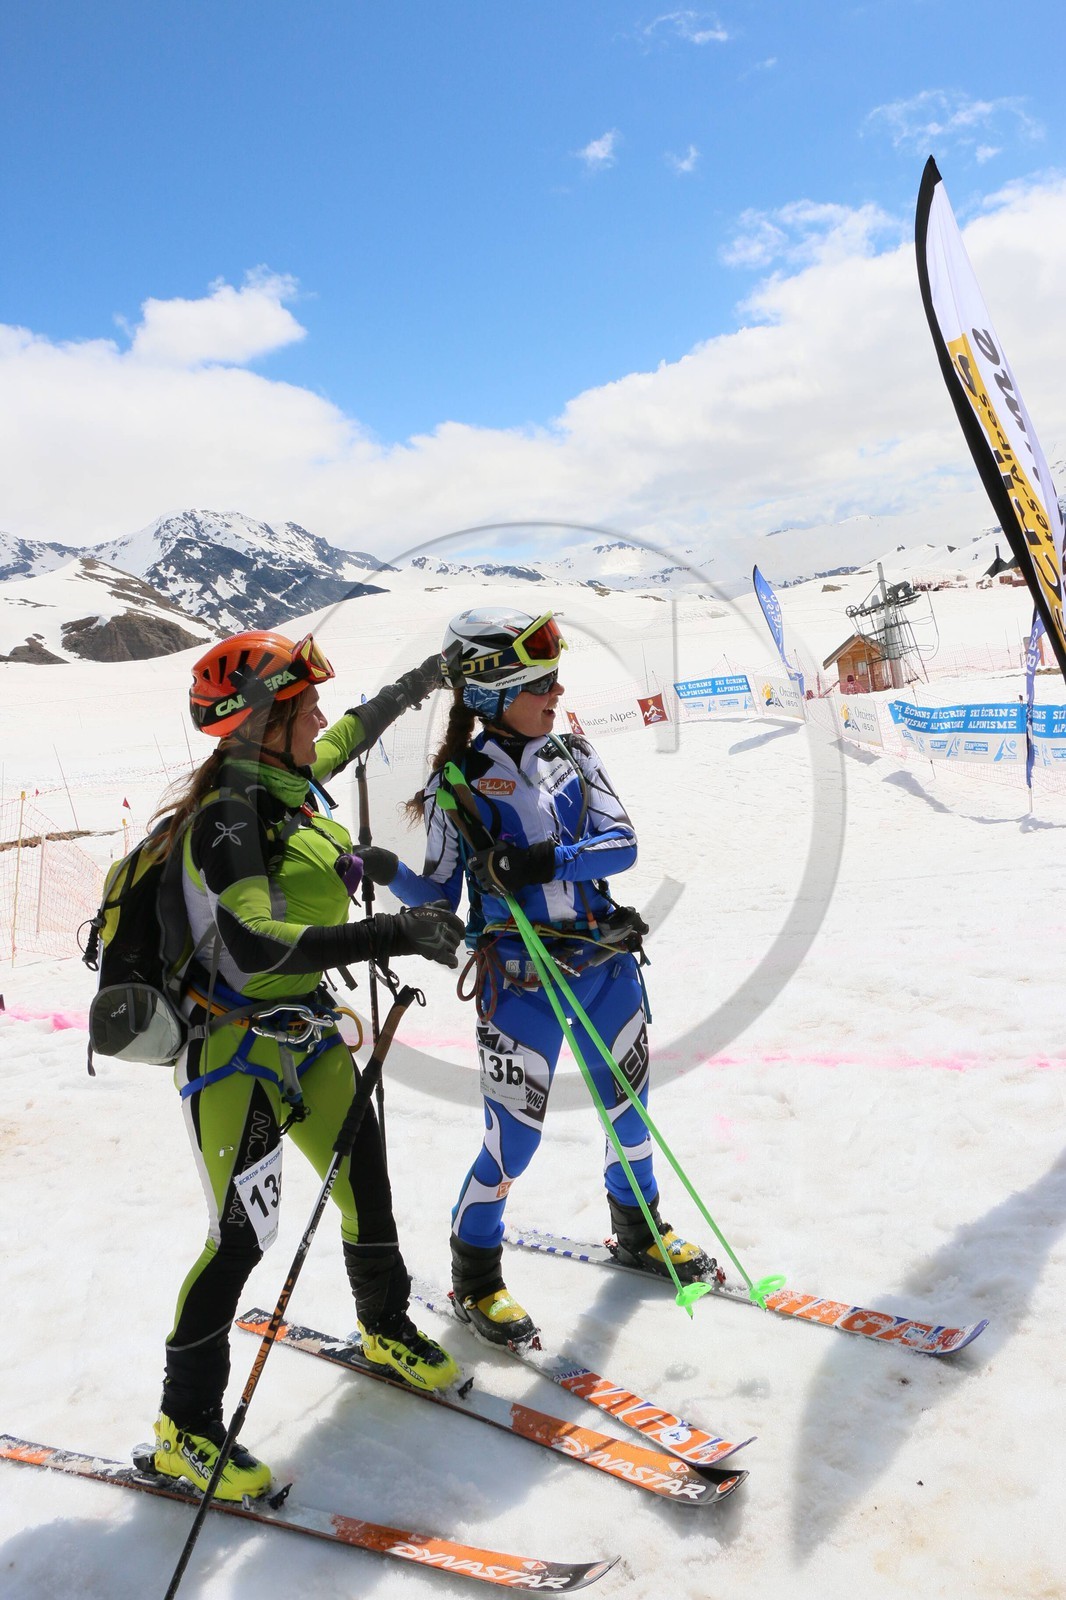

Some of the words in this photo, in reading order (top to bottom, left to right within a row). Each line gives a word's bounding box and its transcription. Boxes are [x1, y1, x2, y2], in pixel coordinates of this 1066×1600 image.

[440, 652, 503, 676] SOTT
[680, 688, 712, 697] ALPINISME
[717, 684, 748, 693] ALPINISME
[580, 716, 608, 727] Hautes
[610, 709, 637, 723] Alpes
[981, 707, 1018, 717] ÉCRINS
[968, 720, 1017, 729] ALPINISME
[479, 780, 514, 791] PLUM
[552, 1435, 707, 1500] DYNASTAR
[385, 1540, 572, 1589] DYNASTAR
